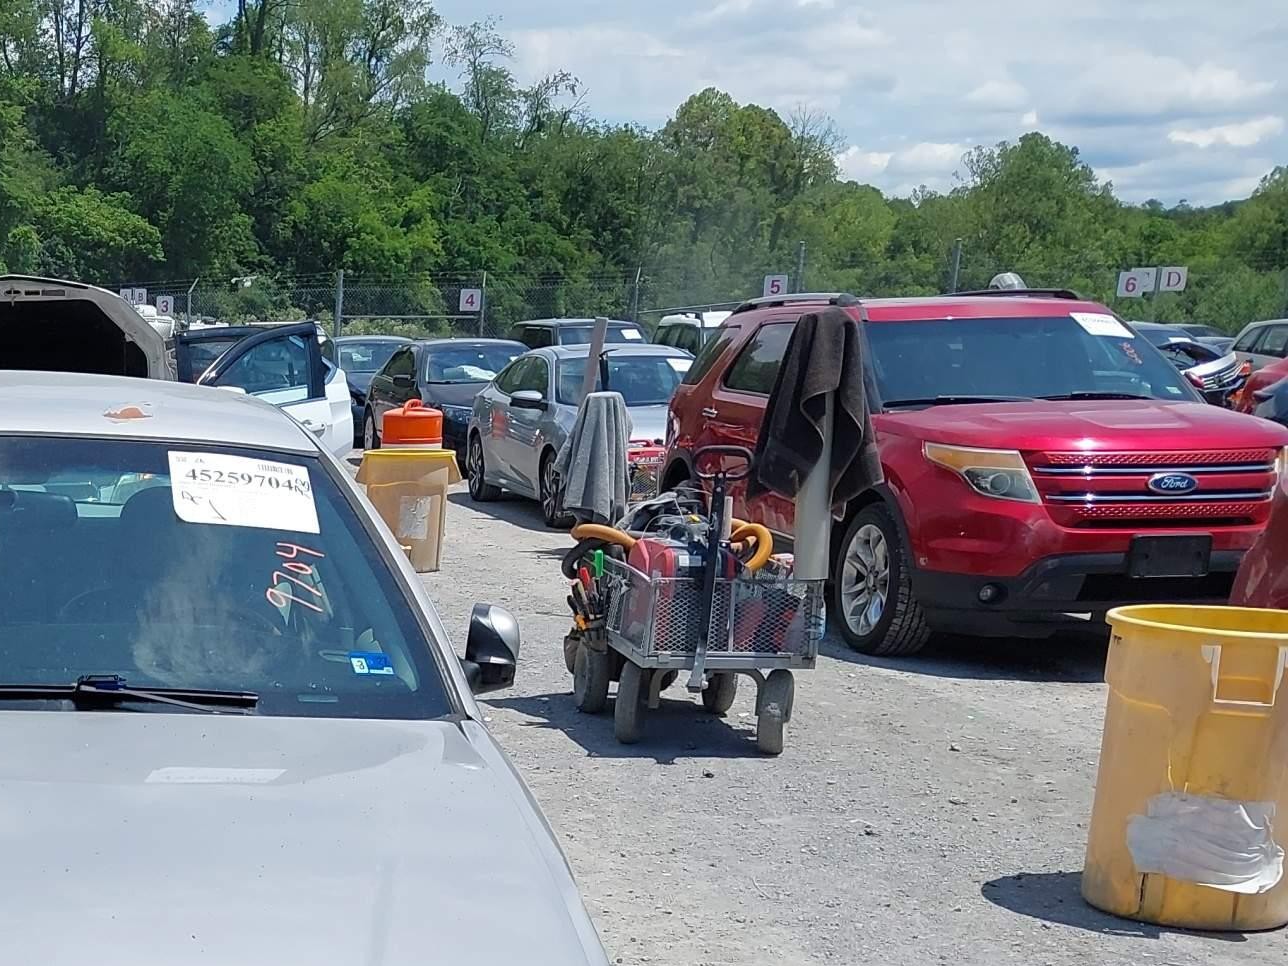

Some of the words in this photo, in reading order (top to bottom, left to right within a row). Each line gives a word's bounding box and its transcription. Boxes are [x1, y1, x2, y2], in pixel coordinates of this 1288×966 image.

[770, 279, 781, 294] 5
[1125, 277, 1137, 292] 6
[1167, 271, 1182, 287] D
[138, 292, 144, 302] B
[465, 293, 475, 307] 4
[161, 300, 169, 313] 3
[185, 468, 294, 492] 45259704
[1161, 476, 1189, 489] Ford
[266, 542, 325, 613] 9704
